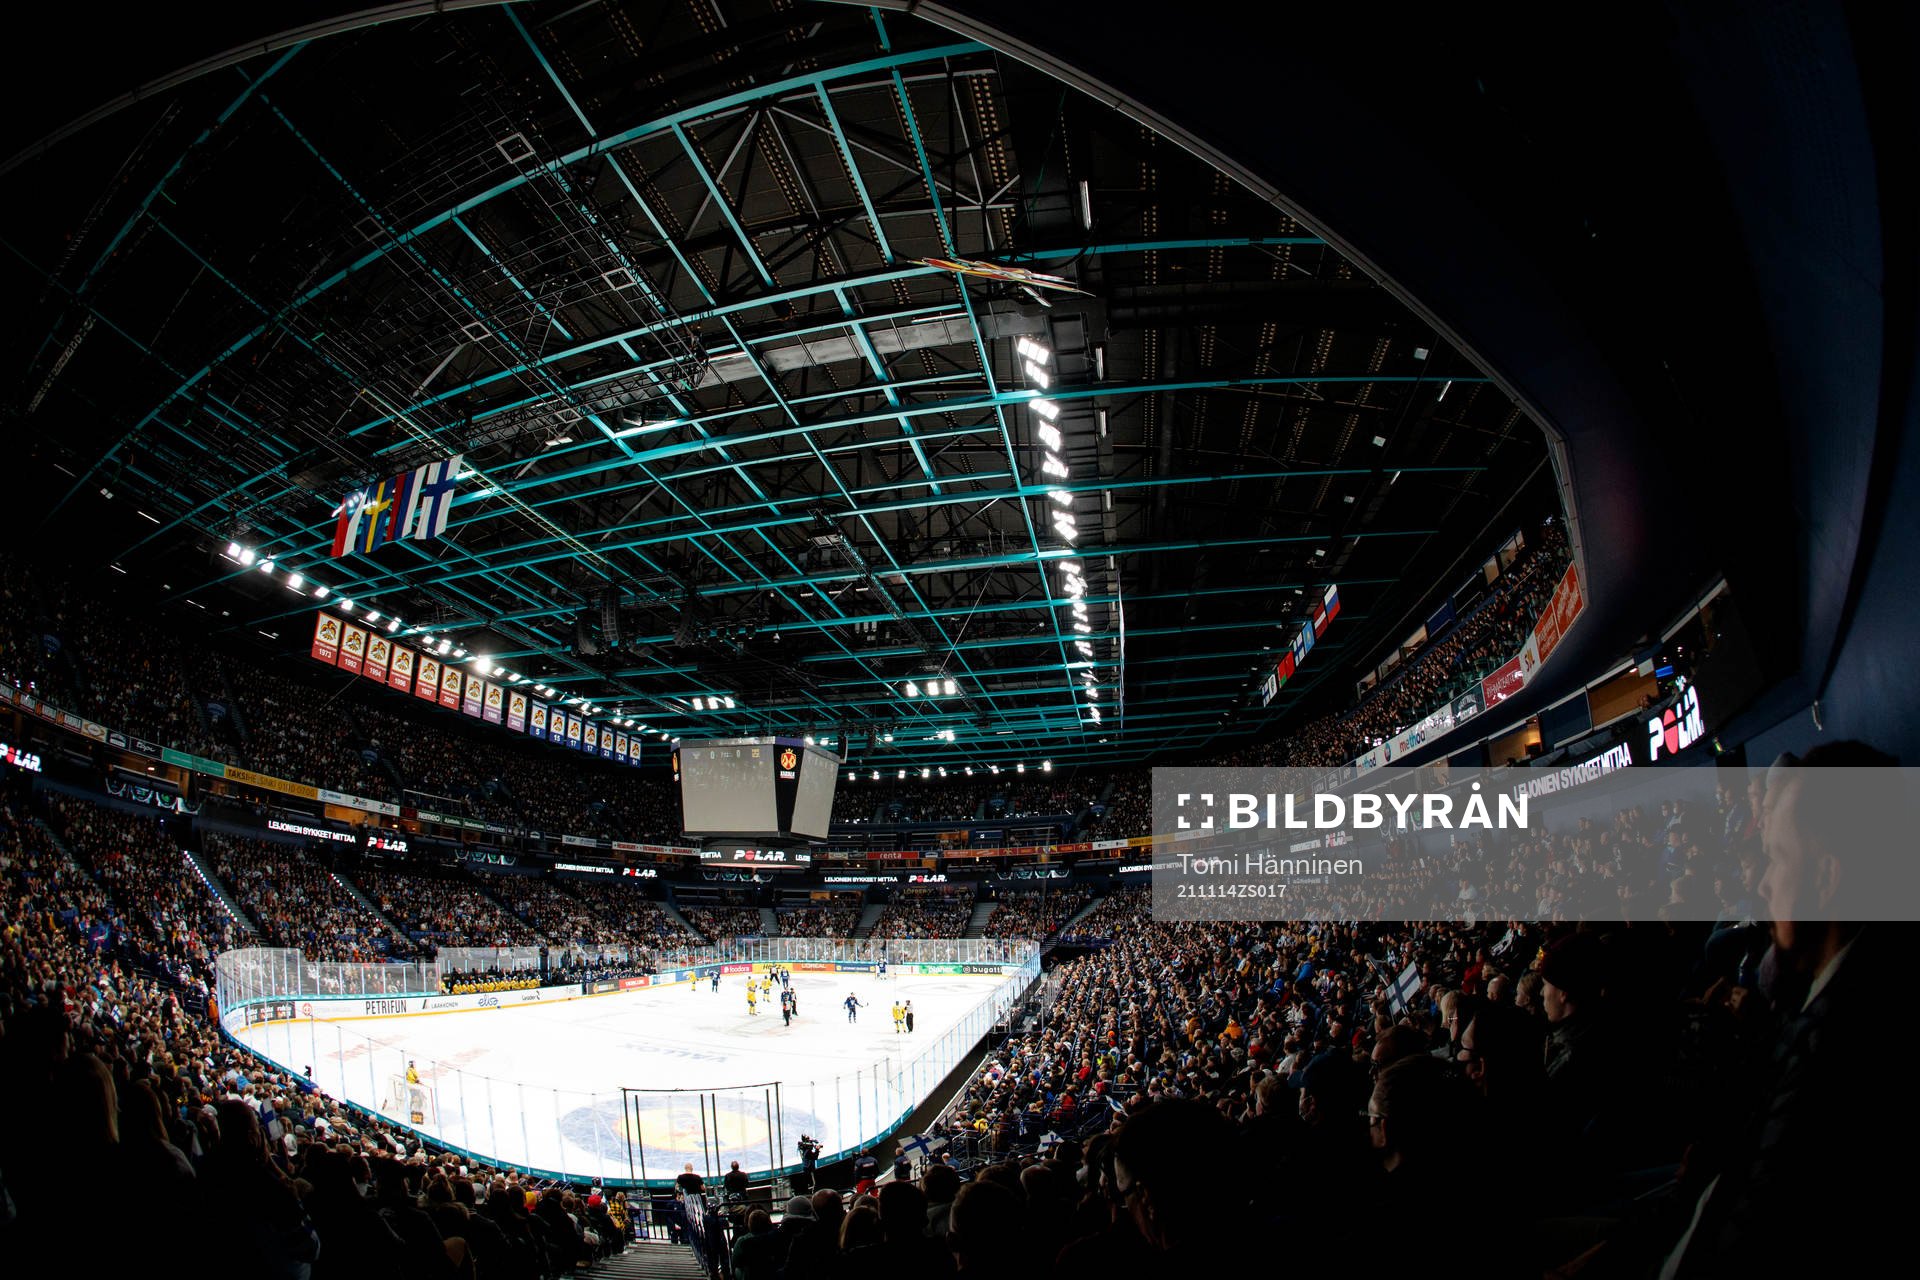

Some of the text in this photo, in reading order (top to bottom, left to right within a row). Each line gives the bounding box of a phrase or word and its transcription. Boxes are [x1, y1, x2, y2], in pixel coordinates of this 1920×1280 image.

[1514, 742, 1633, 803] LEIJONIEN SYKKEET MITTAA
[267, 820, 303, 834] LEIJONIEN
[302, 827, 332, 839] SYKKEET
[332, 832, 356, 843] MITTAA
[365, 999, 407, 1015] PETRIFUN
